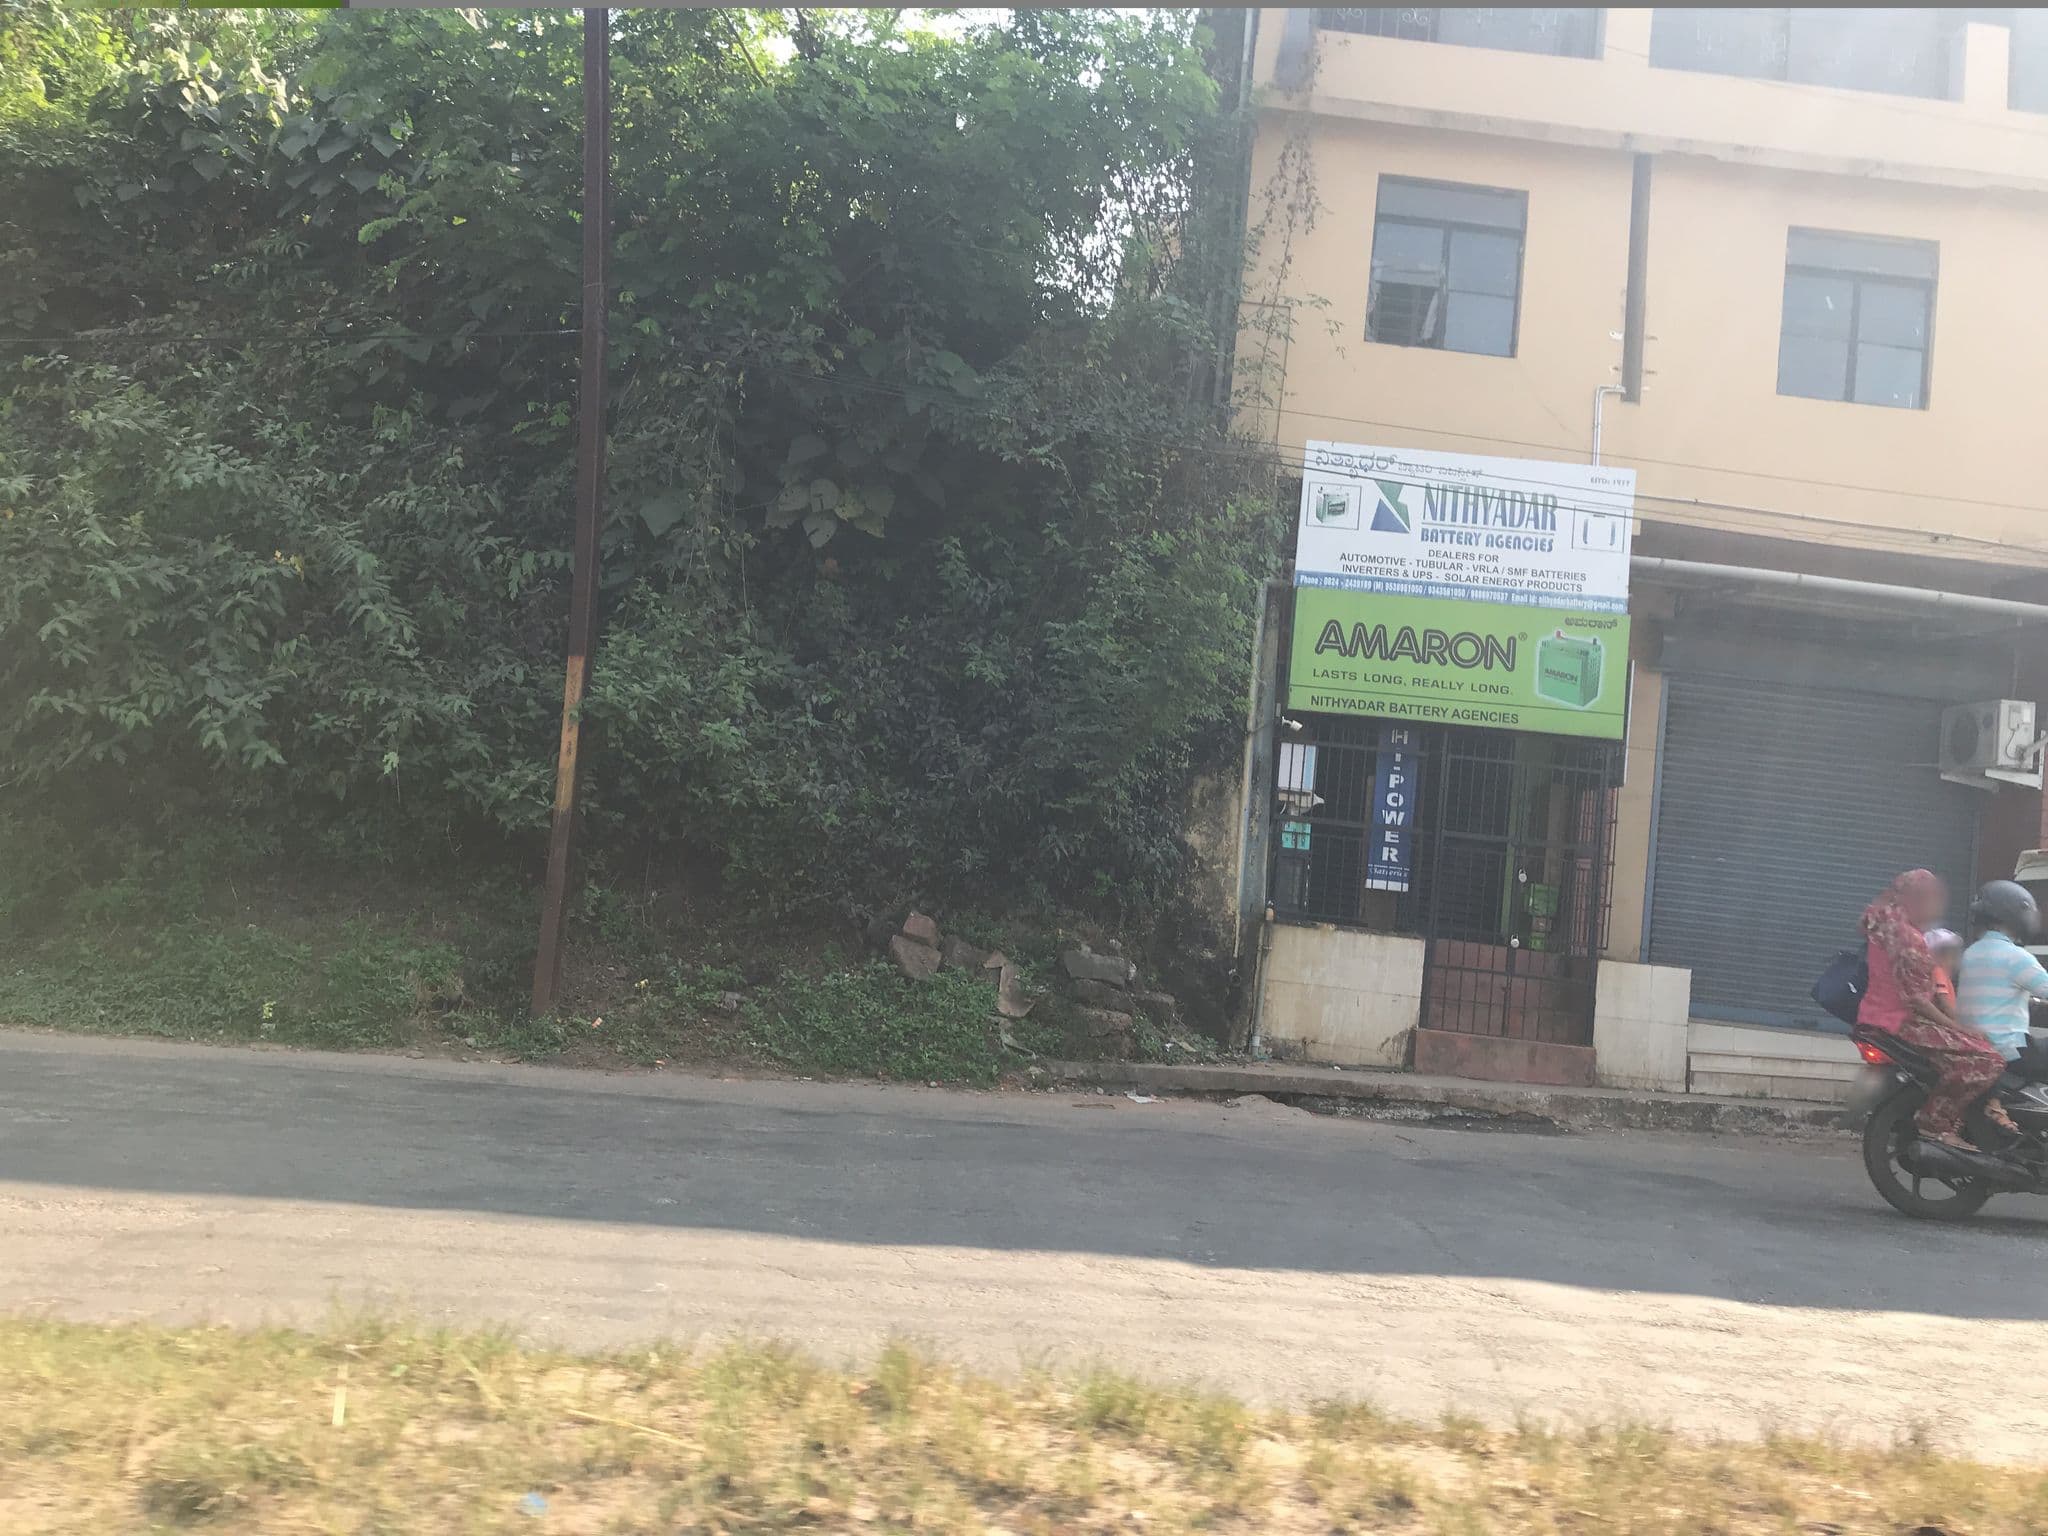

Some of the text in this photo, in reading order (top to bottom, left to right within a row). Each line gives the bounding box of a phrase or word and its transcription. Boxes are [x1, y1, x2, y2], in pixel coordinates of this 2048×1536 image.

[1423, 482, 1558, 531] NITHYADAR
[1420, 527, 1554, 553] BATTERY AGENCIES
[1339, 552, 1407, 567] AUTOMOTIVE
[1415, 559, 1464, 571] TUBULAR
[1472, 564, 1499, 575] VRLA
[1507, 567, 1529, 577] SMF
[1531, 569, 1587, 582] BATTERIES
[1428, 549, 1500, 563] DEALERS FOR
[1300, 574, 1319, 585] Phone
[1342, 564, 1400, 577] INVERTERS
[1402, 570, 1409, 578] &
[1412, 570, 1433, 580] UPS
[1444, 573, 1479, 584] SOLAR
[1482, 577, 1524, 588] ENERGY
[1526, 581, 1583, 592] PRODUCTS
[1315, 619, 1516, 672] AMARON
[1312, 668, 1358, 681] LASTS
[1363, 673, 1407, 686] LONG,
[1411, 677, 1465, 691] REALLY
[1310, 695, 1520, 724] NITHYADAR BATTERY AGENCIES
